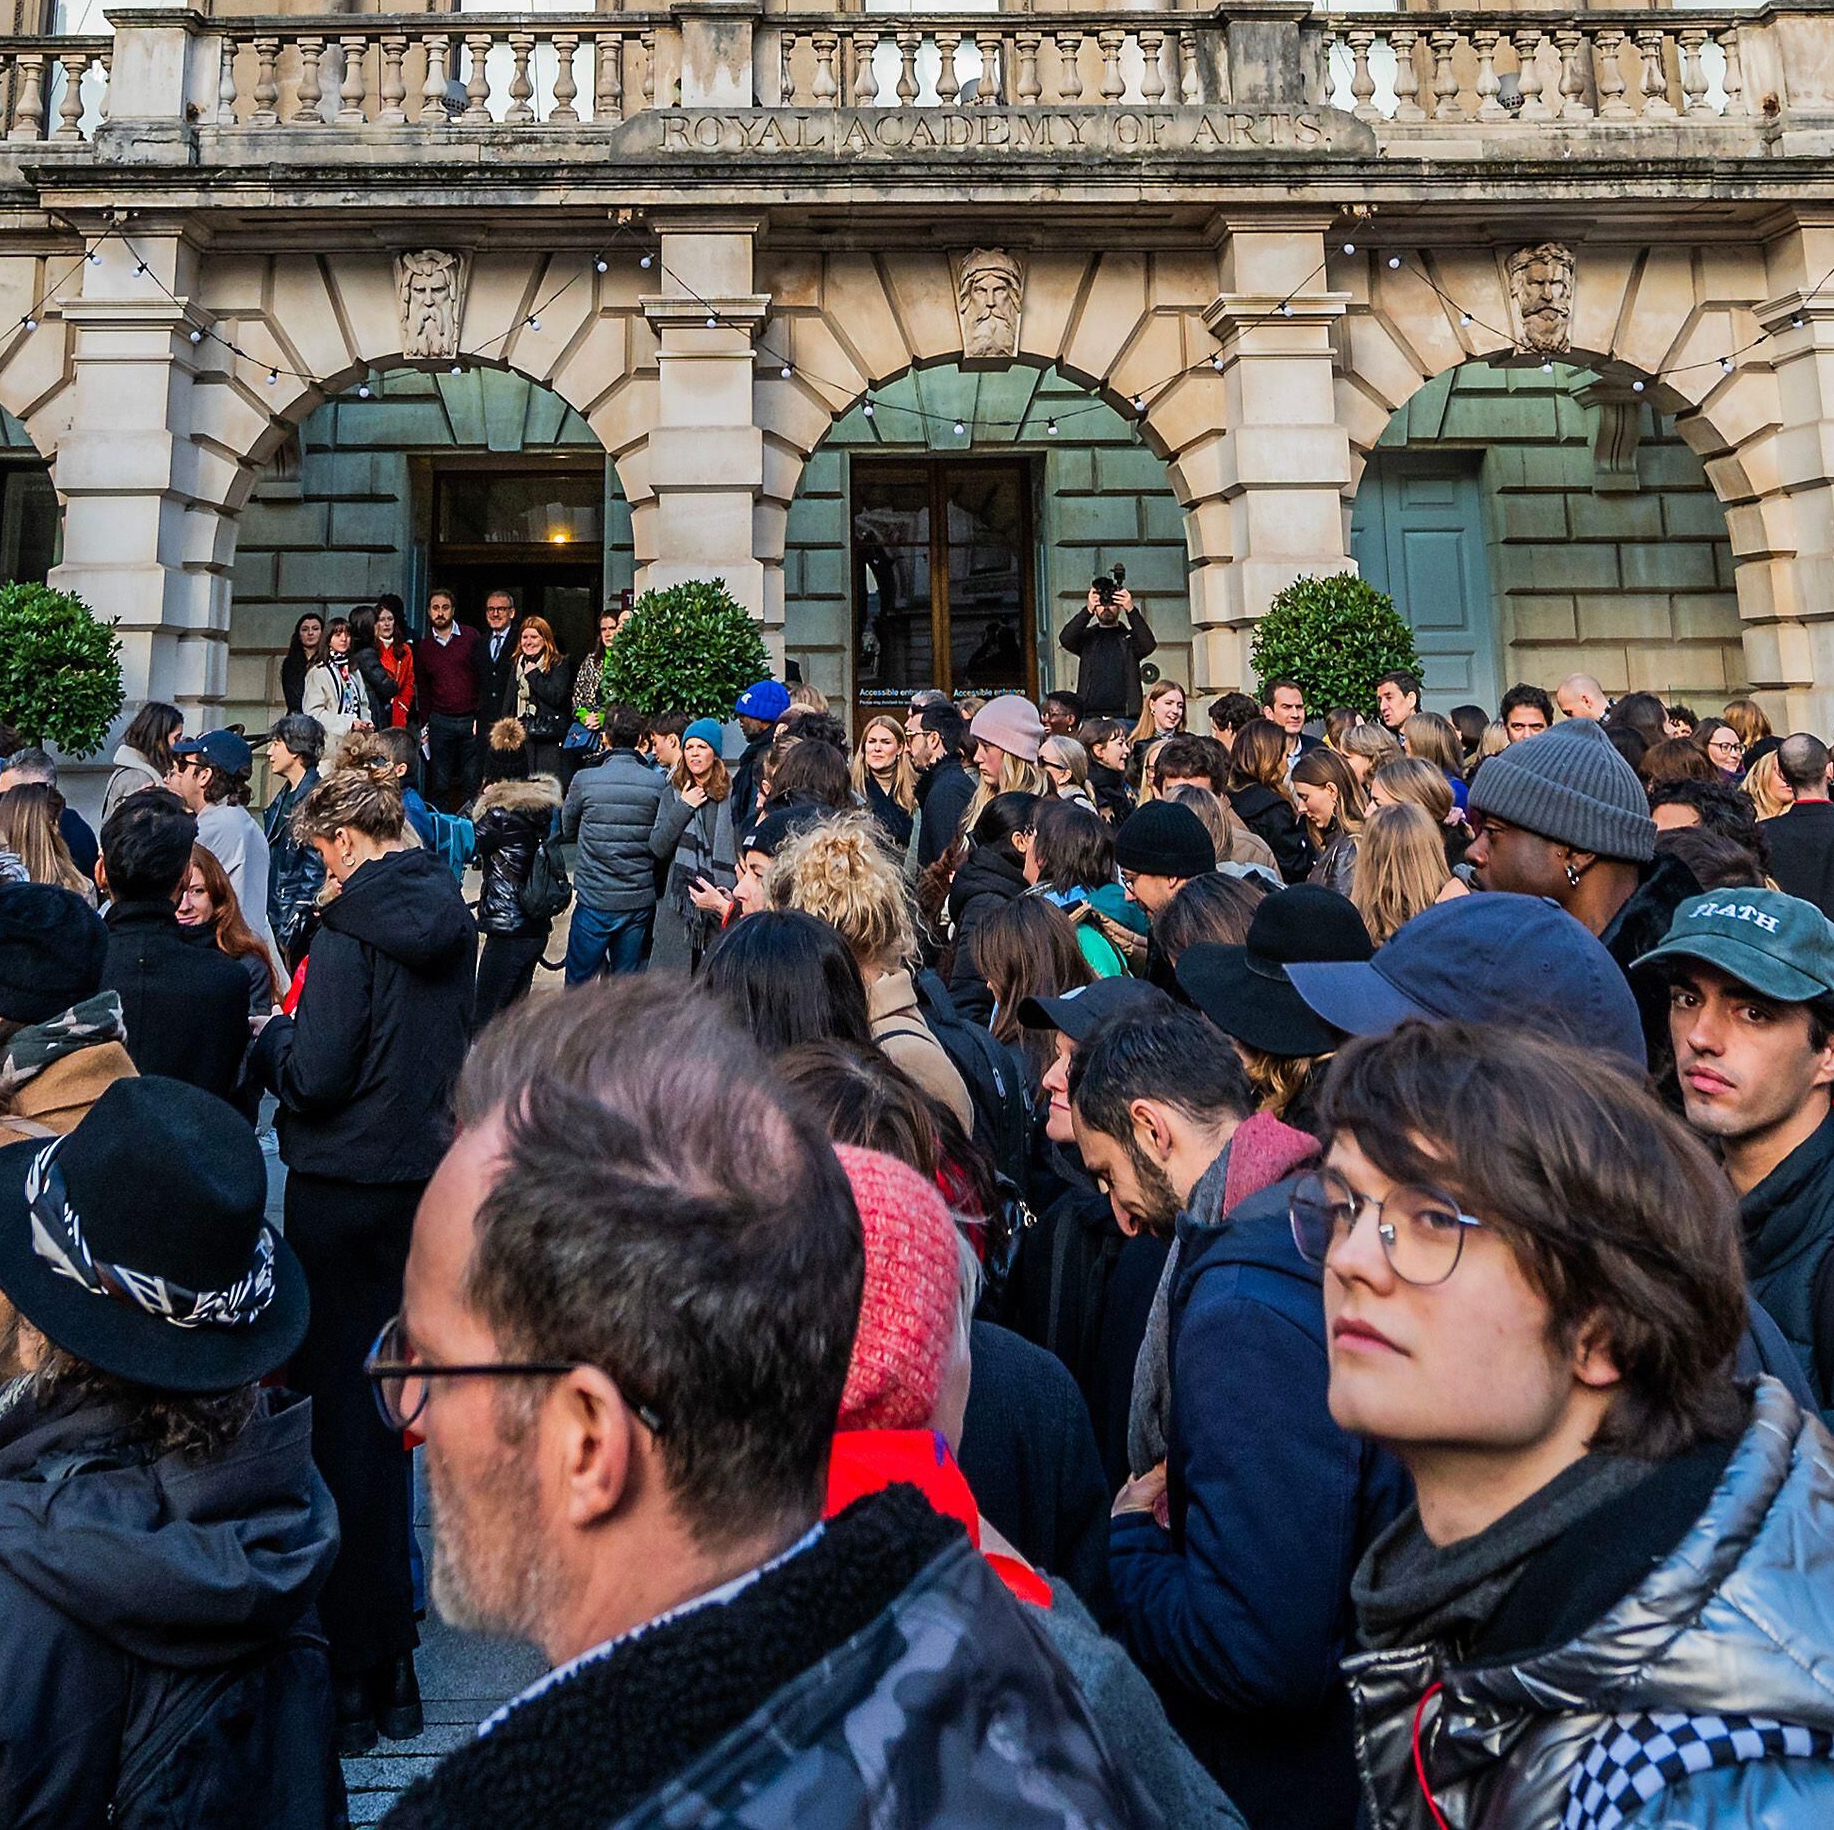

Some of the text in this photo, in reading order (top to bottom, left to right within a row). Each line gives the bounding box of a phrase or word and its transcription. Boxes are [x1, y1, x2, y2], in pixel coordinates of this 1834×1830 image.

[658, 116, 825, 148] ROYAL
[841, 114, 1097, 148] ACADEMY
[1113, 113, 1174, 146] OF
[859, 688, 898, 696] Accessible
[953, 688, 993, 696] Accessible
